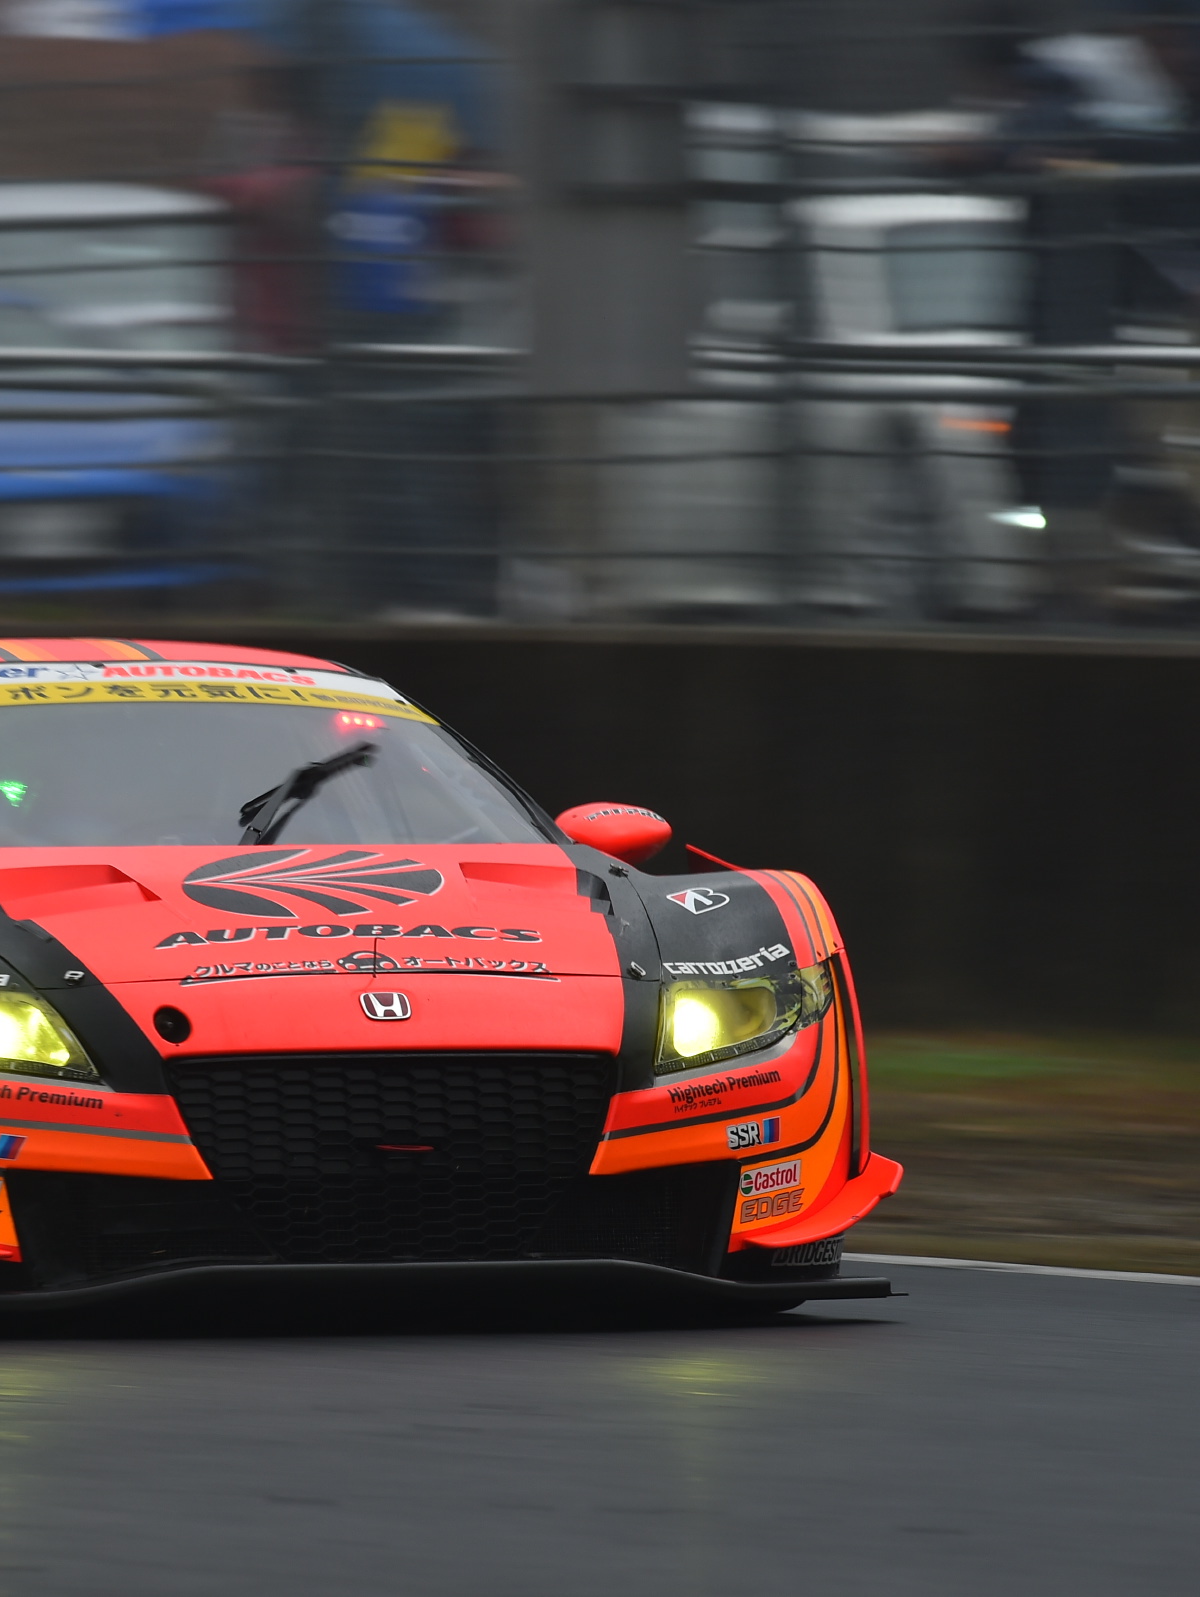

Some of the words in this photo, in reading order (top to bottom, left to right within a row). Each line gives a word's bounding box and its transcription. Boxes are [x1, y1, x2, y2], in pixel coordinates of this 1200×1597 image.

[103, 665, 317, 686] AUTOBACS
[154, 924, 543, 950] AUTOBACS
[402, 956, 552, 974] オートバックス
[662, 943, 790, 975] carrozzeria
[15, 1087, 104, 1110] Premium
[667, 1079, 728, 1104] Hightech
[726, 1070, 782, 1092] Premium
[727, 1121, 762, 1151] SSR
[754, 1164, 798, 1192] Castrol
[740, 1188, 805, 1224] EDGE
